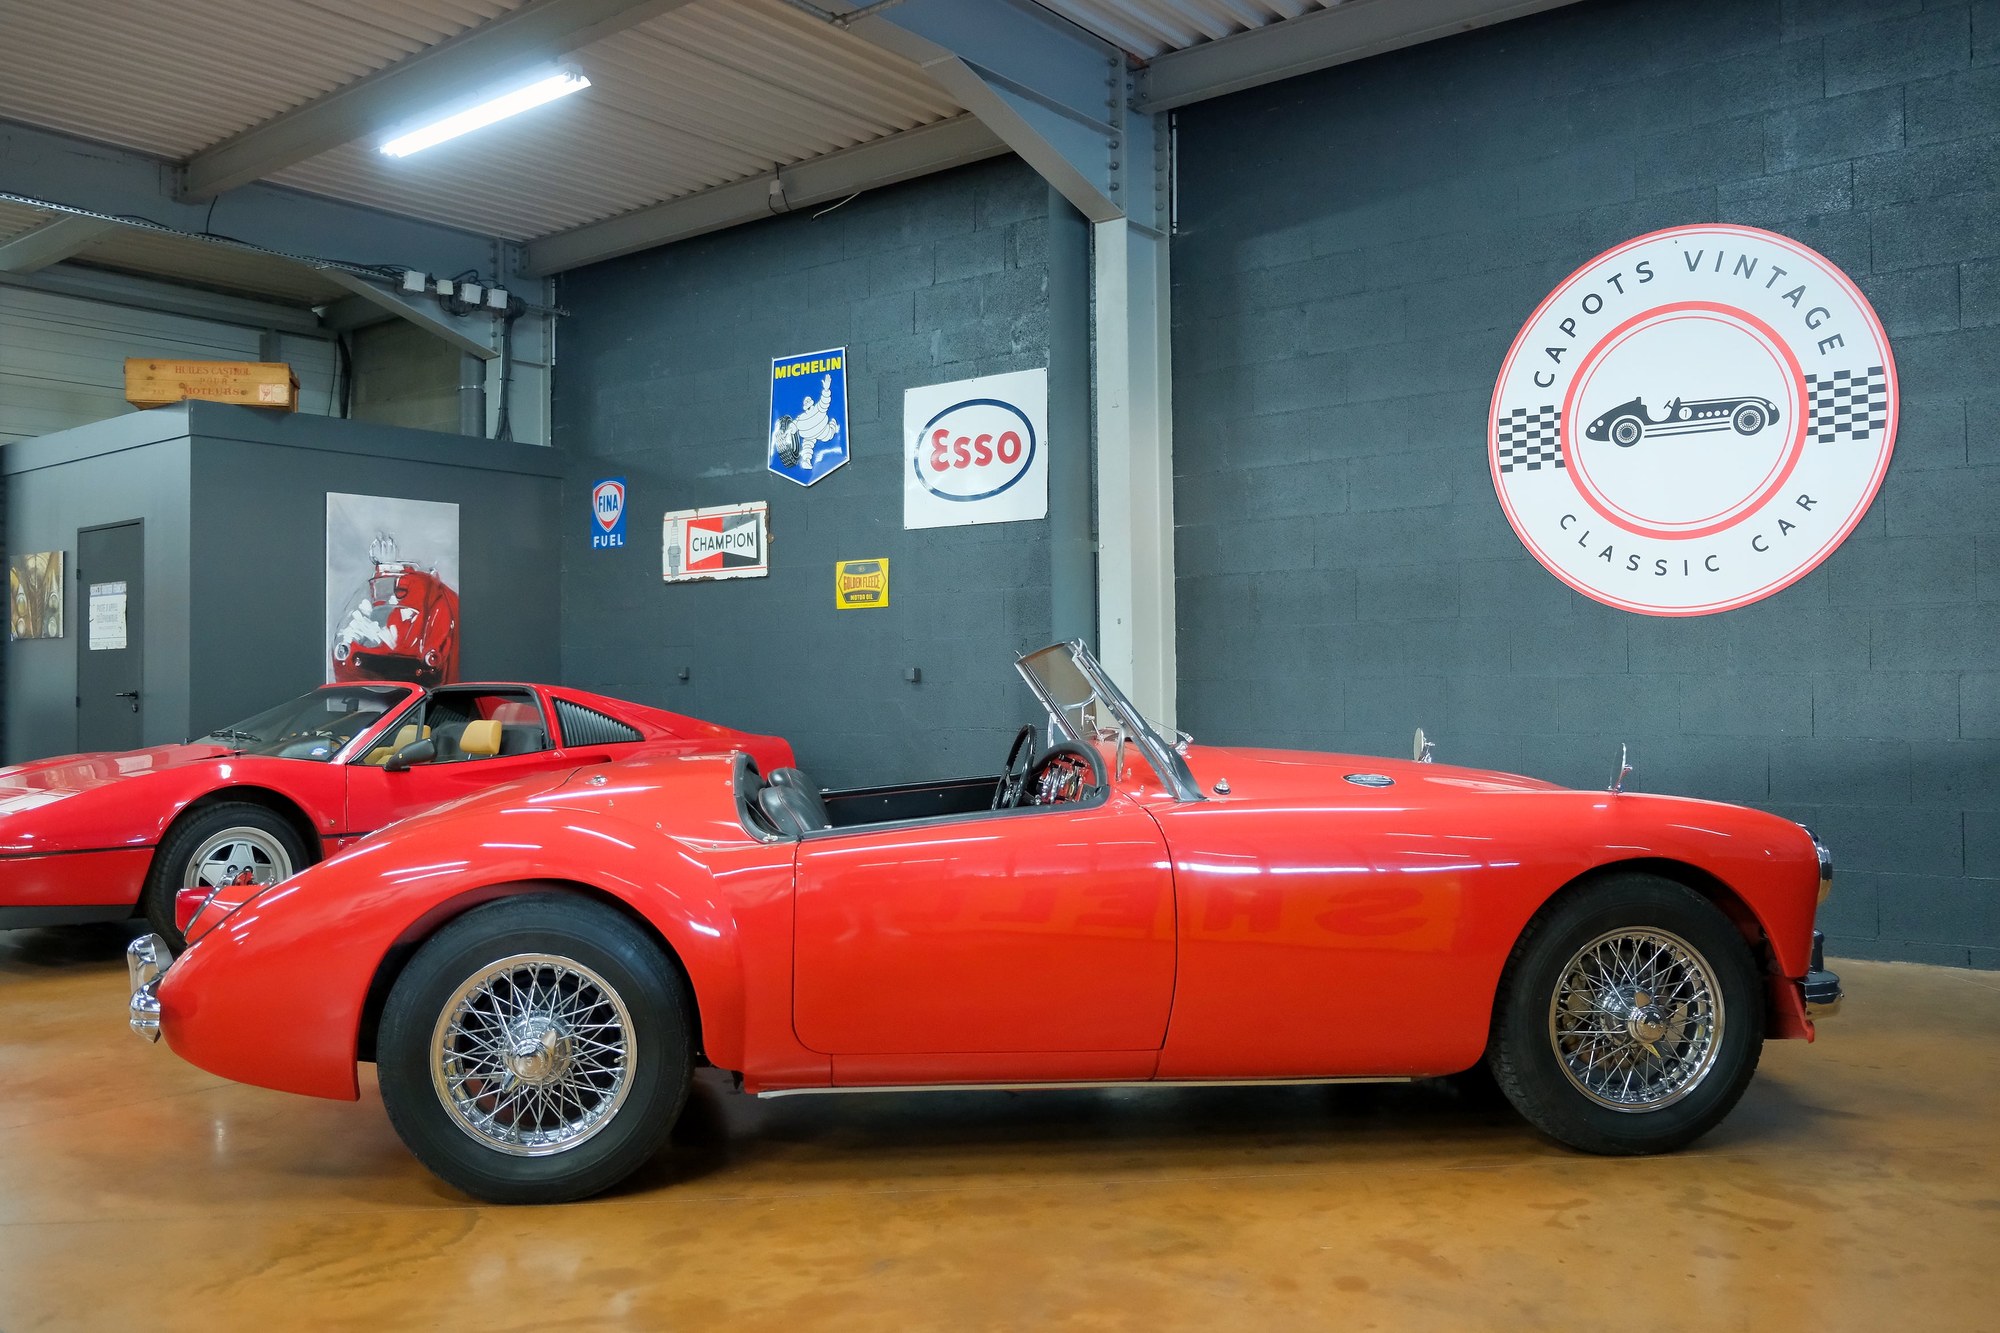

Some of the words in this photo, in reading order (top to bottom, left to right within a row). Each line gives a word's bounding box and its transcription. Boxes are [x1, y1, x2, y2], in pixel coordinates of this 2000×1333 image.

[1533, 260, 1655, 388] CAPOTS
[1683, 249, 1845, 356] VINTAGE
[175, 365, 209, 374] HUILES
[211, 367, 251, 376] CASTROL
[775, 357, 842, 379] MICHELIN
[200, 377, 228, 386] POUR
[183, 387, 240, 396] MOTEURS
[598, 494, 619, 513] FINA
[593, 533, 623, 548] FUEL
[692, 532, 754, 552] CHAMPION
[1559, 514, 1720, 576] CLASSIC
[1751, 493, 1818, 553] CAR
